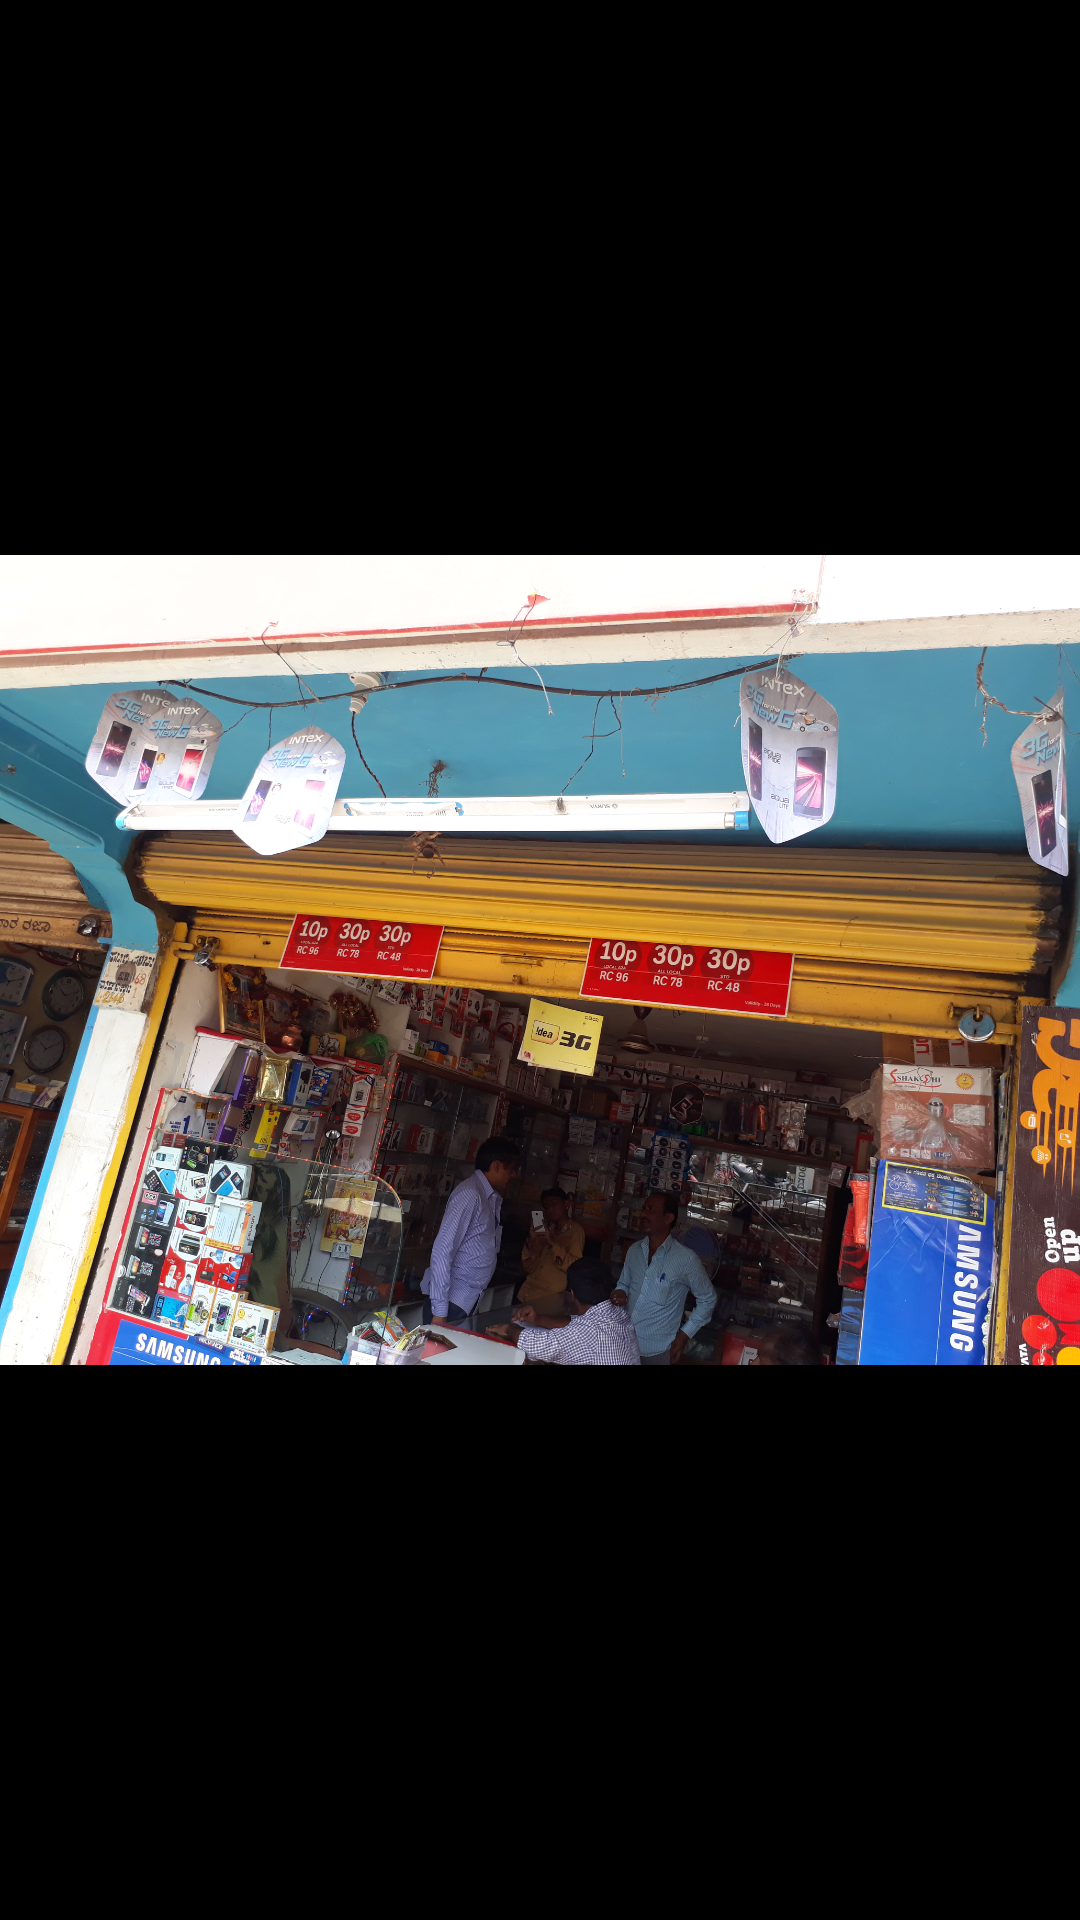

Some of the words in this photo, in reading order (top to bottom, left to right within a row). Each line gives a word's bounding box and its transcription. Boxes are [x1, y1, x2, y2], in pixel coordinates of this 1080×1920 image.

[744, 680, 765, 705] 3G
[115, 696, 142, 713] 3G
[149, 718, 170, 731] 3G
[1021, 729, 1049, 758] 3G
[268, 748, 292, 761] 3G
[299, 920, 329, 941] 10p
[339, 922, 371, 944] 30p
[379, 924, 412, 947] 30p
[296, 945, 309, 955] RC
[309, 946, 319, 955] 96
[336, 948, 349, 958] RC
[349, 949, 360, 958] 78
[377, 951, 389, 960] RC
[390, 952, 401, 961] 48
[599, 941, 637, 966] 10p
[652, 944, 694, 971] 30p
[706, 948, 751, 976] 30p
[599, 970, 614, 981] RC
[615, 972, 629, 983] 96
[652, 975, 669, 987] RC
[670, 977, 683, 988] 78
[707, 980, 724, 991] RC
[725, 982, 740, 993] 48
[559, 1030, 593, 1051] 3G
[1043, 1216, 1062, 1264] Open
[1060, 1228, 1080, 1264] up
[950, 1225, 982, 1353] AMSUNG
